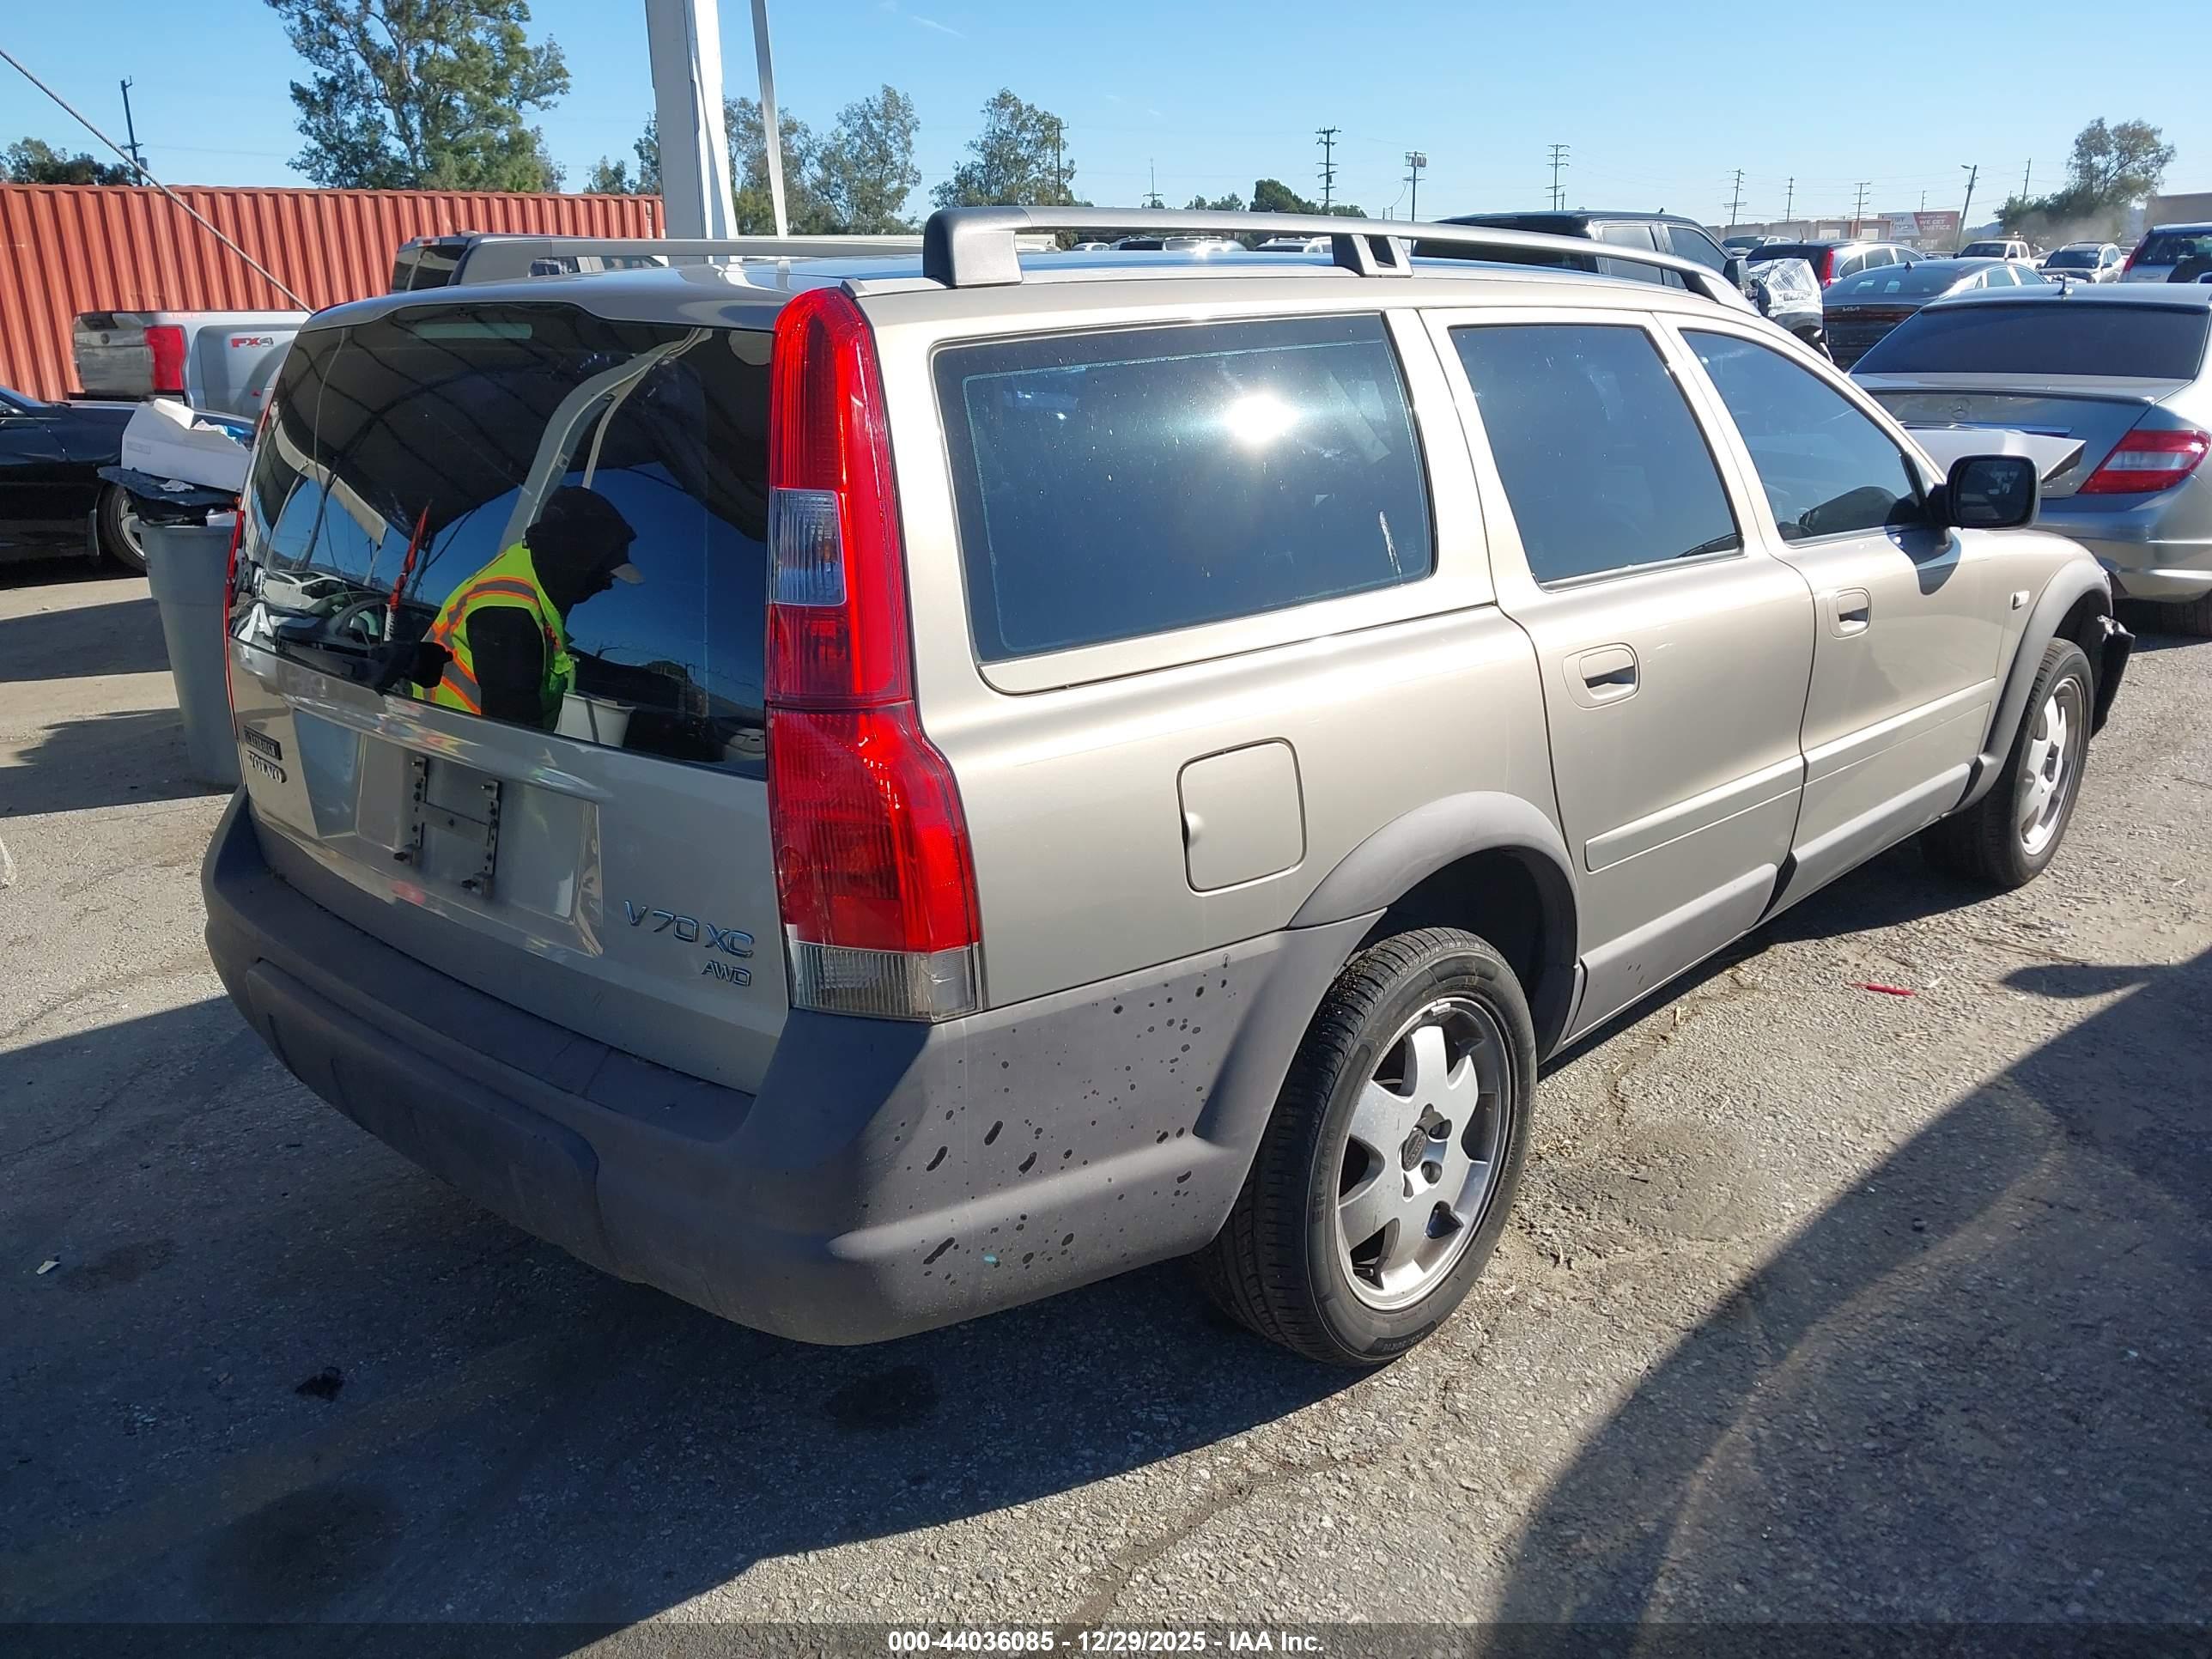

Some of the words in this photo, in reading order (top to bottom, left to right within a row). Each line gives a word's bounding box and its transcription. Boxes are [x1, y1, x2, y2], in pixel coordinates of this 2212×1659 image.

[231, 337, 274, 348] FX4
[246, 750, 284, 783] VOLVO
[704, 922, 755, 958] XC
[701, 959, 752, 988] AWD
